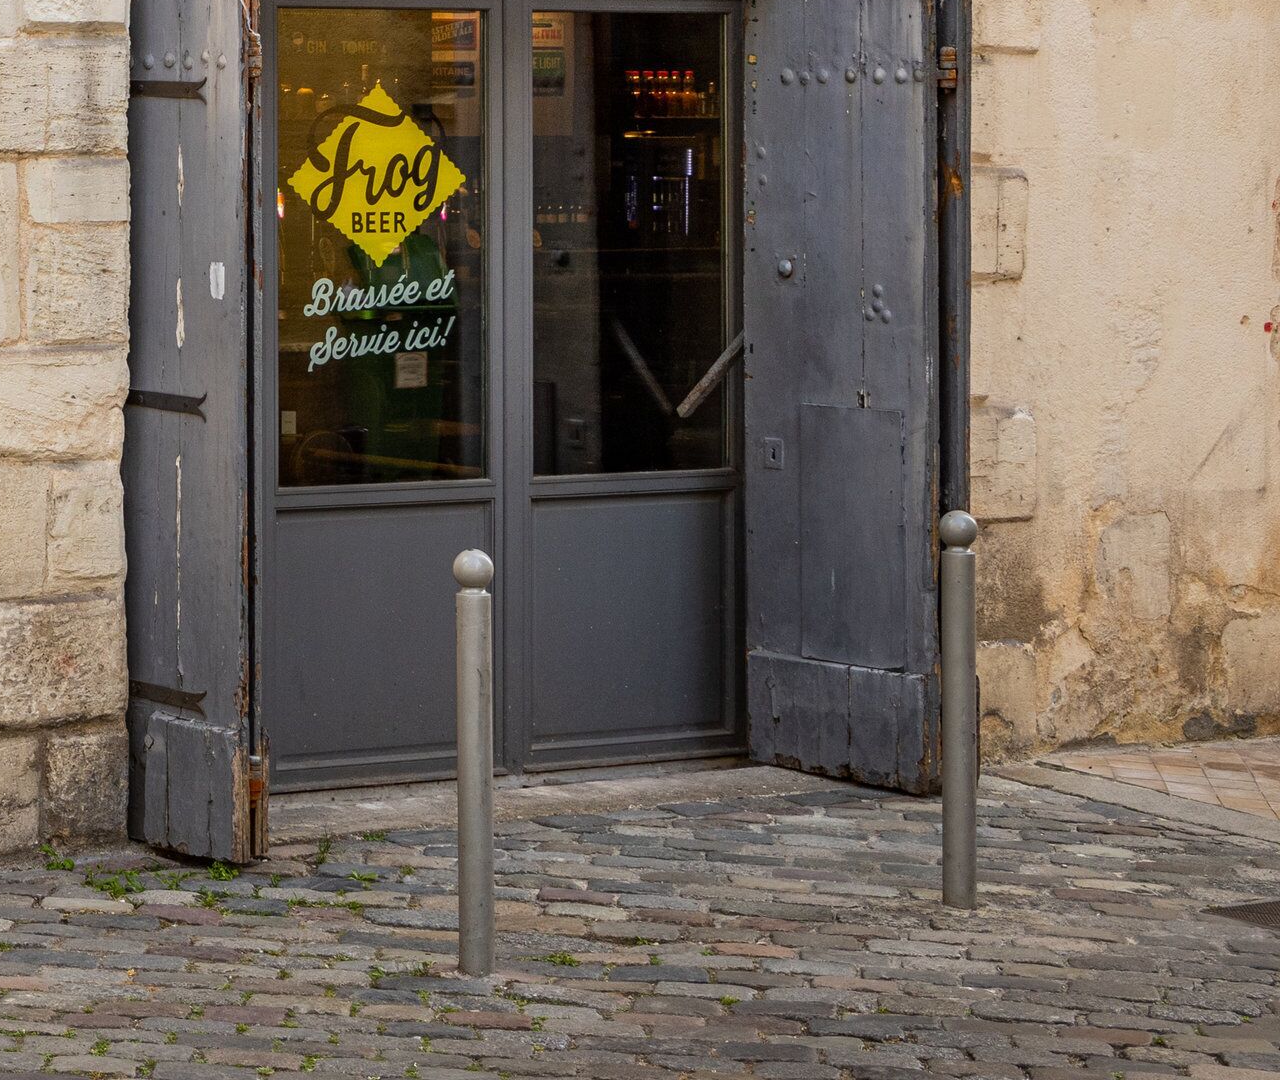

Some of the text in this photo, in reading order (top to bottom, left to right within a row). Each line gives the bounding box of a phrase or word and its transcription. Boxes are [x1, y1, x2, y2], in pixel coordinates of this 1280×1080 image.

[352, 212, 407, 233] BEER
[303, 269, 455, 317] Brassée et
[308, 324, 401, 373] Servie
[404, 315, 456, 348] ici!
